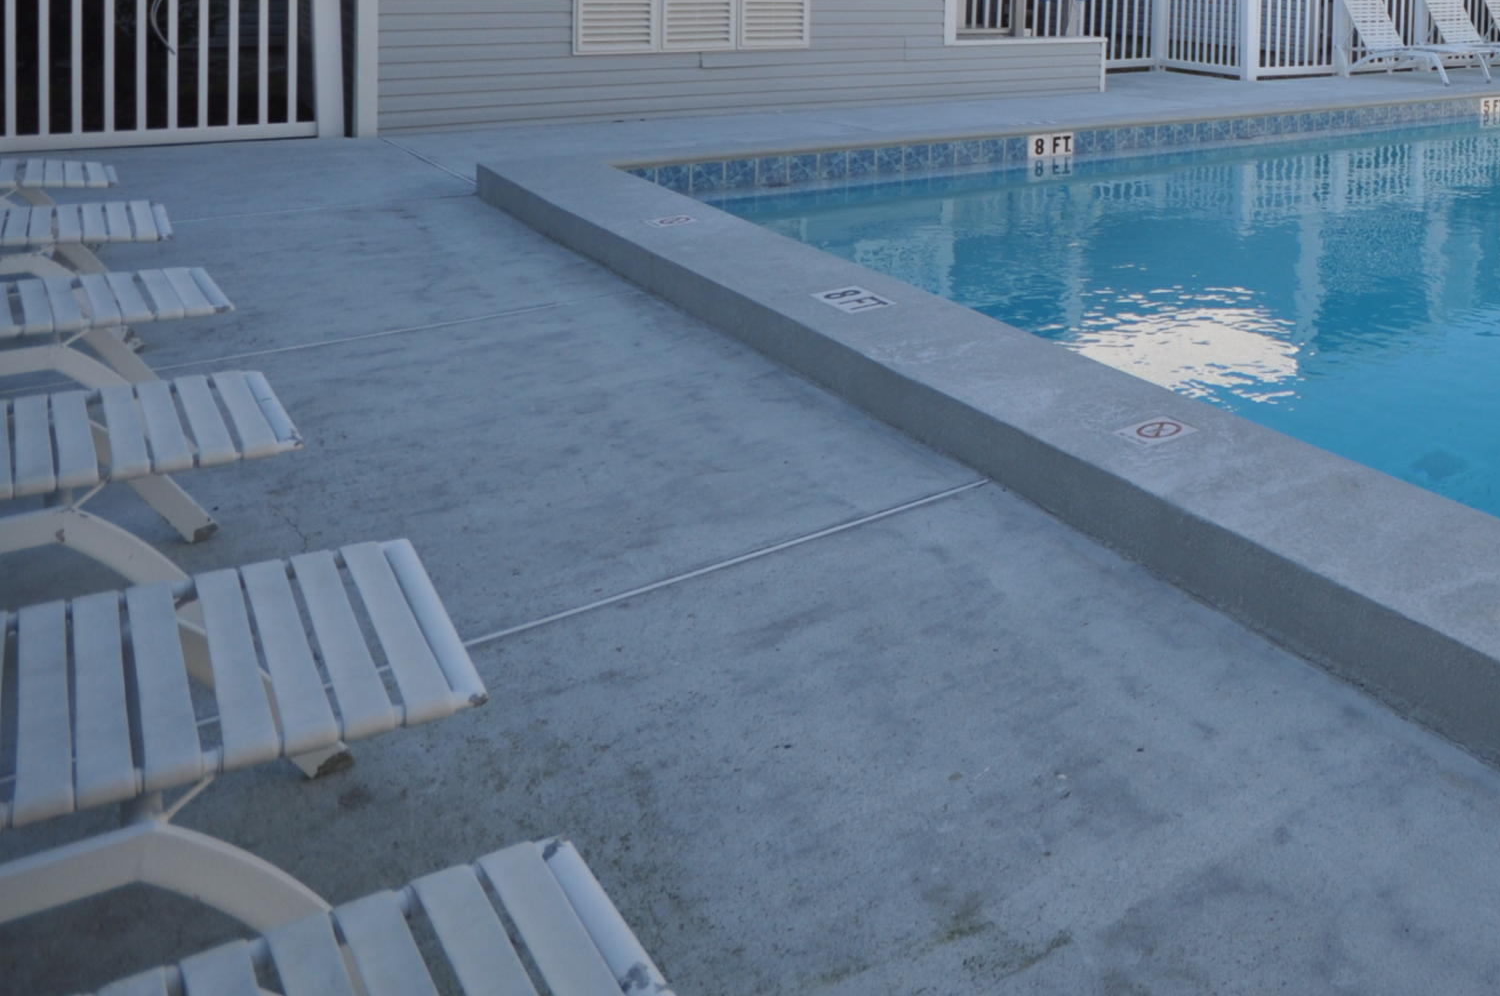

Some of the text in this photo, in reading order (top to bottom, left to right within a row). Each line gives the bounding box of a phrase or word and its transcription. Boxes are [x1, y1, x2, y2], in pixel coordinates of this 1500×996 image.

[1483, 99, 1490, 113] 5
[1035, 138, 1044, 155] 8
[823, 290, 889, 310] 8 FT
